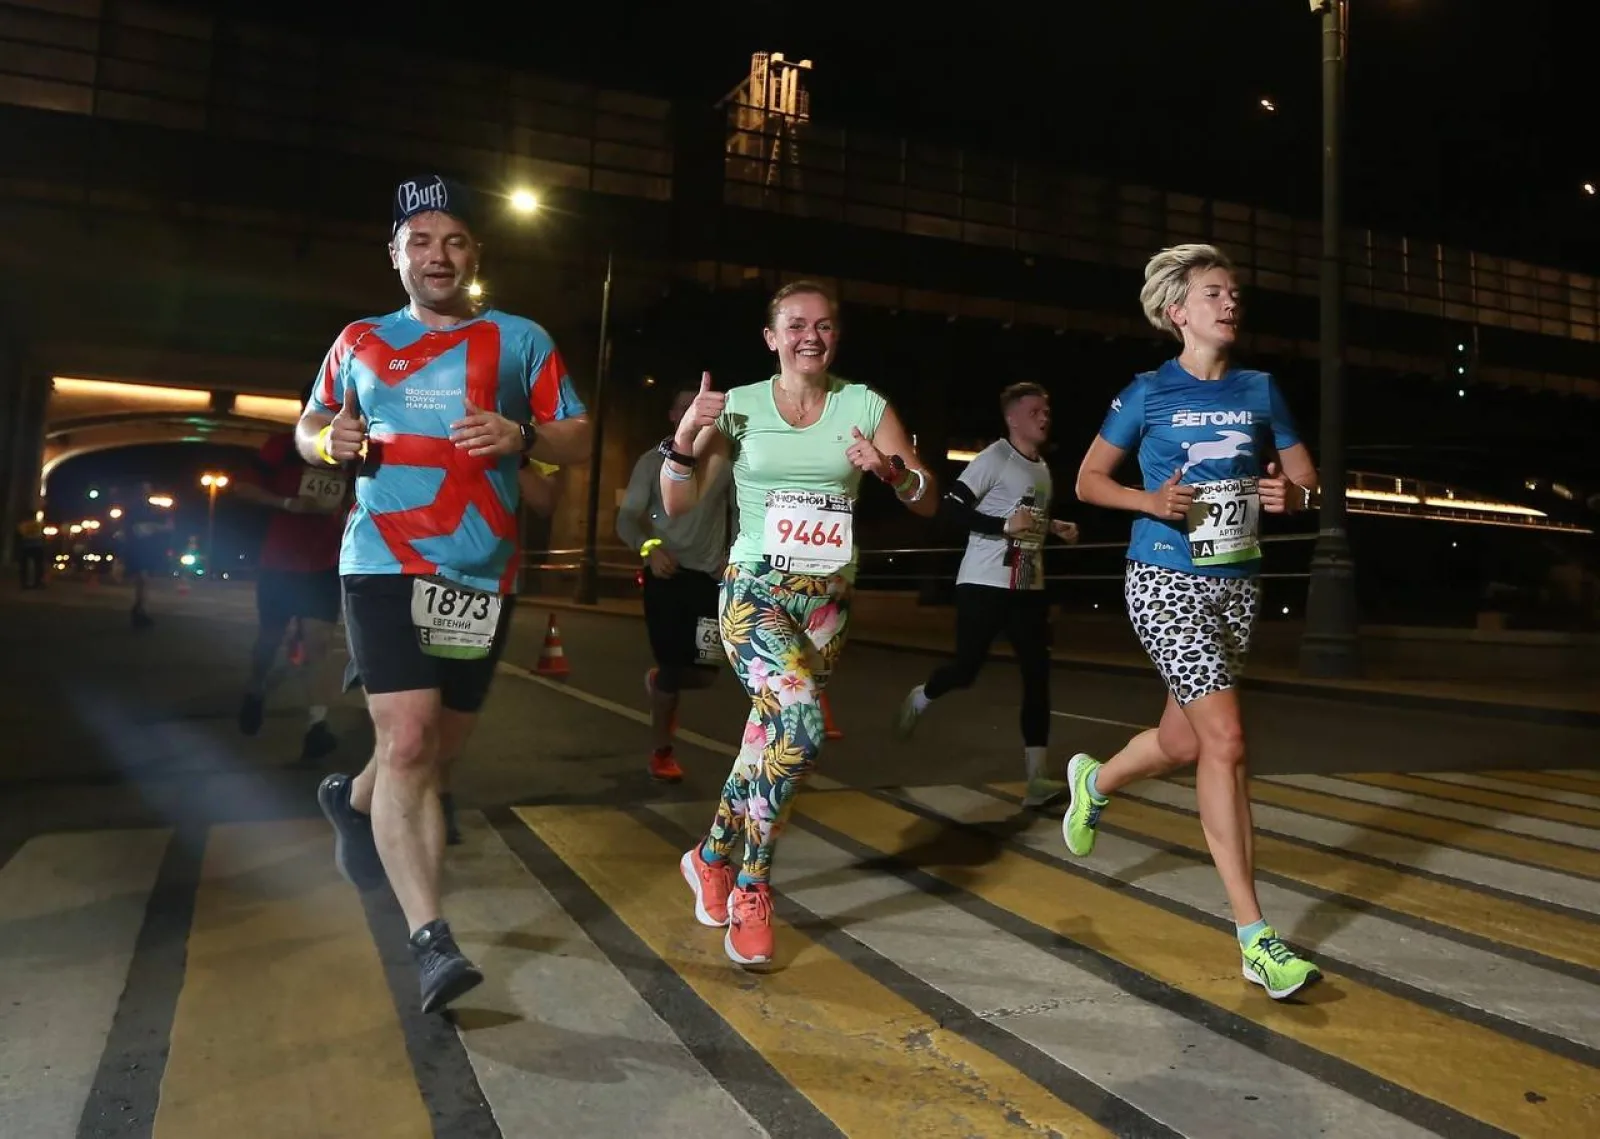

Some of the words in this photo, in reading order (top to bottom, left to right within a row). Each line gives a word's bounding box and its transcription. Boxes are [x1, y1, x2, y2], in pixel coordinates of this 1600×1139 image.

[1209, 500, 1248, 527] 927
[777, 518, 843, 548] 9464
[775, 554, 785, 568] D
[425, 586, 490, 620] 1873
[433, 617, 471, 630] ЕВГЕНИЙ
